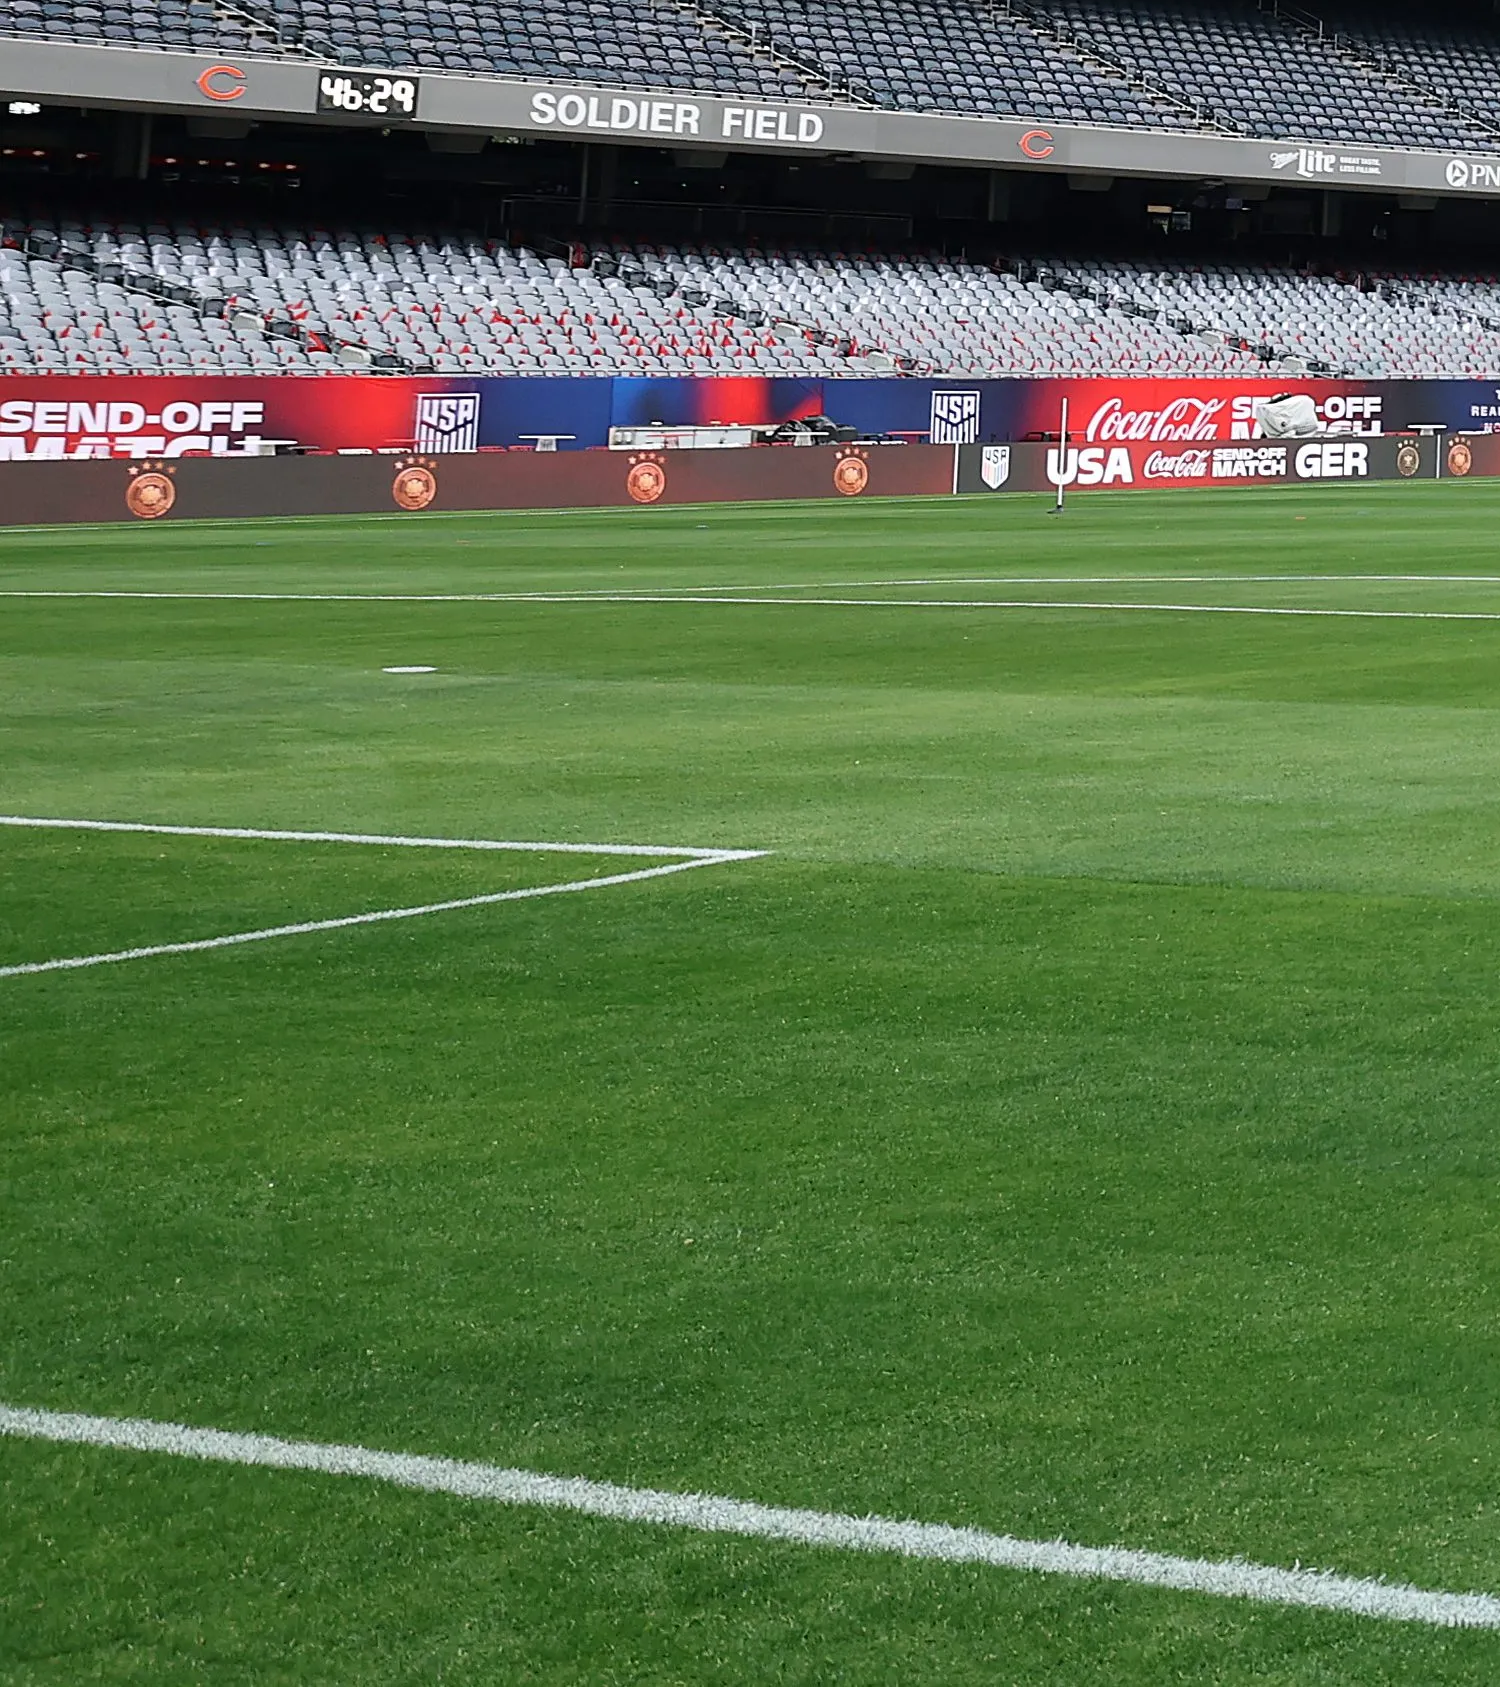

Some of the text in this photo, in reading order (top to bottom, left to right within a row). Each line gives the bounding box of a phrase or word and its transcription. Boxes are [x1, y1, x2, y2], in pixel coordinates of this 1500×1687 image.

[320, 76, 415, 113] 46:29
[530, 92, 824, 143] SOLDIER FIELD
[1297, 149, 1336, 178] Lite
[0, 401, 264, 434] SEND-OFF
[419, 397, 477, 432] USA
[934, 394, 976, 425] USA
[1085, 397, 1228, 442] Coca-Cola
[985, 449, 1006, 465] USA
[1047, 447, 1134, 485] USA
[1143, 449, 1212, 479] Coca-Cola
[1212, 460, 1287, 478] MATCH
[1213, 447, 1287, 462] SEND-OFF
[1295, 442, 1369, 479] GER
